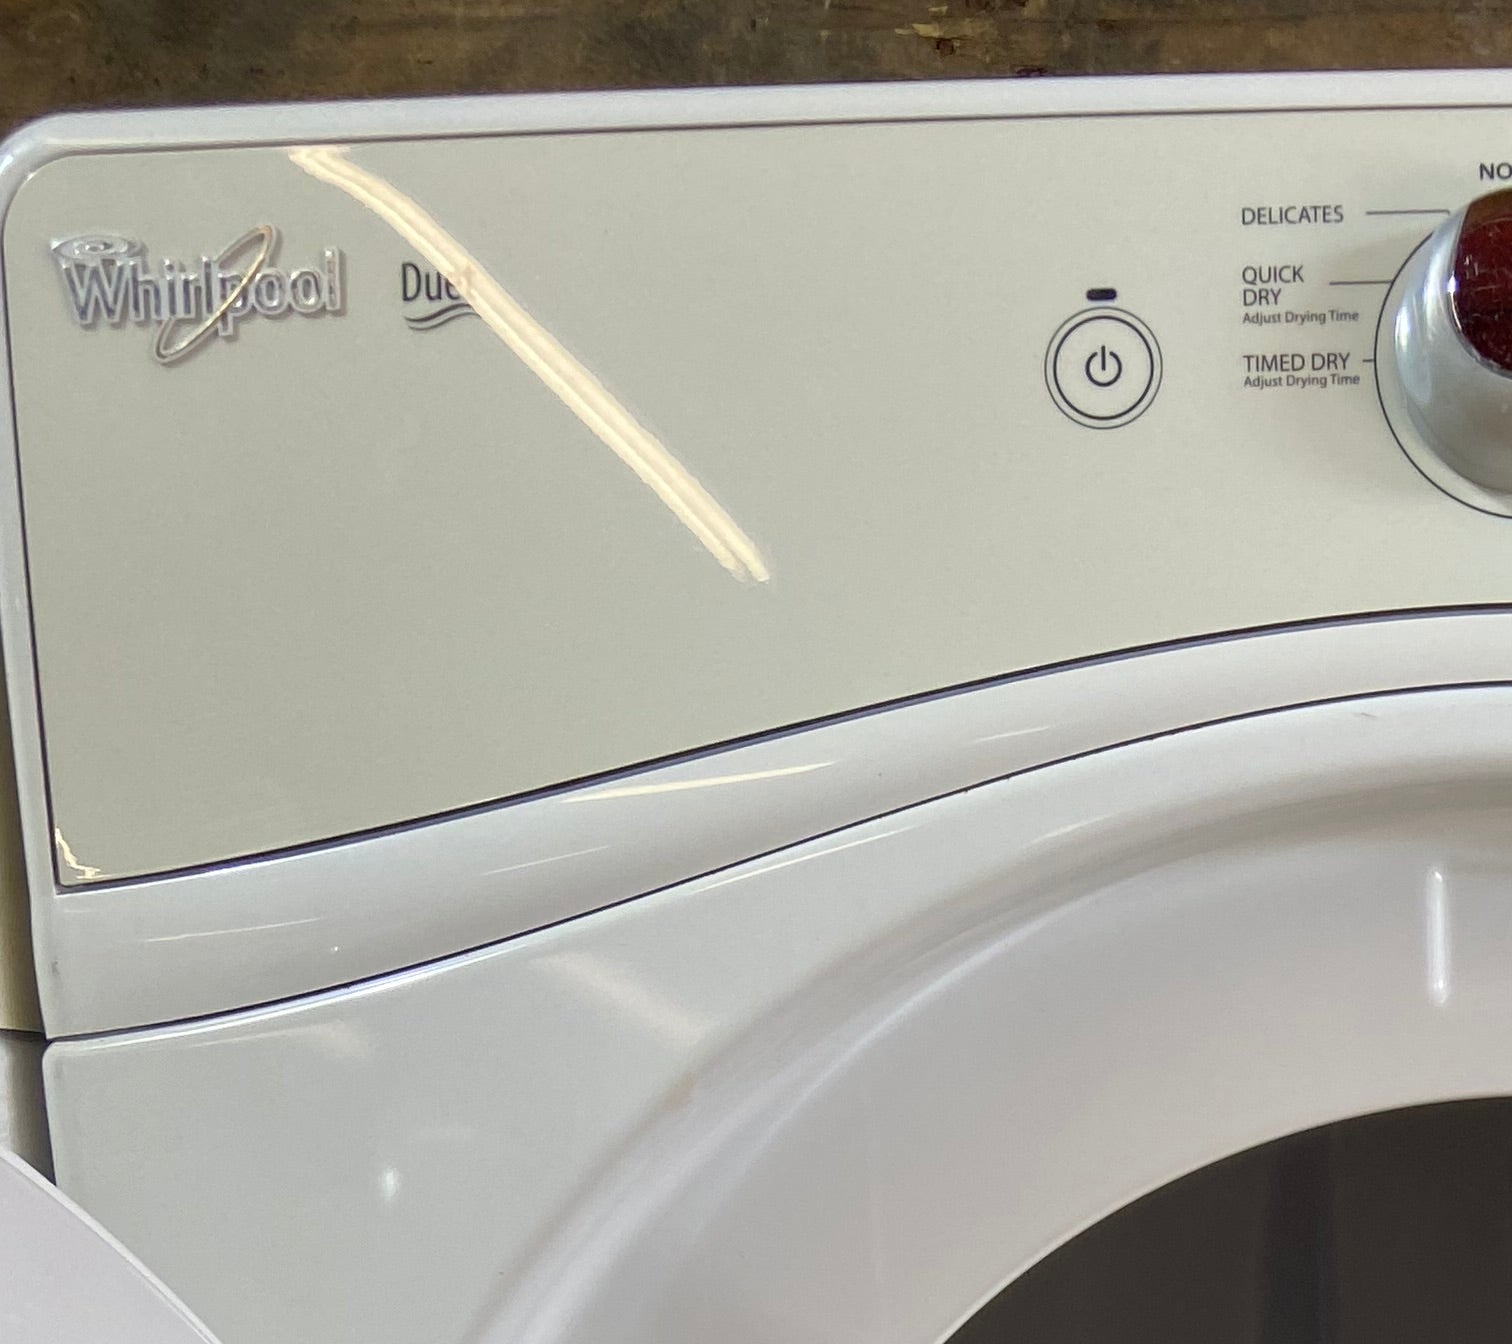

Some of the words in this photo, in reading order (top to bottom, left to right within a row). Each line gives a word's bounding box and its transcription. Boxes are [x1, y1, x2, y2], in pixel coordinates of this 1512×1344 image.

[1241, 204, 1344, 226] DELICATES
[1242, 265, 1305, 285] QUICK
[56, 246, 347, 337] Whirlpool
[1243, 288, 1282, 307] DRY
[1242, 311, 1281, 326] Adjust
[1285, 311, 1326, 326] Drying
[1328, 309, 1359, 322] Time
[1242, 354, 1305, 373] TIMED
[1311, 352, 1350, 371] DRY
[1244, 375, 1282, 390] Adjust
[1286, 374, 1327, 389] Drying
[1330, 373, 1360, 385] Time
